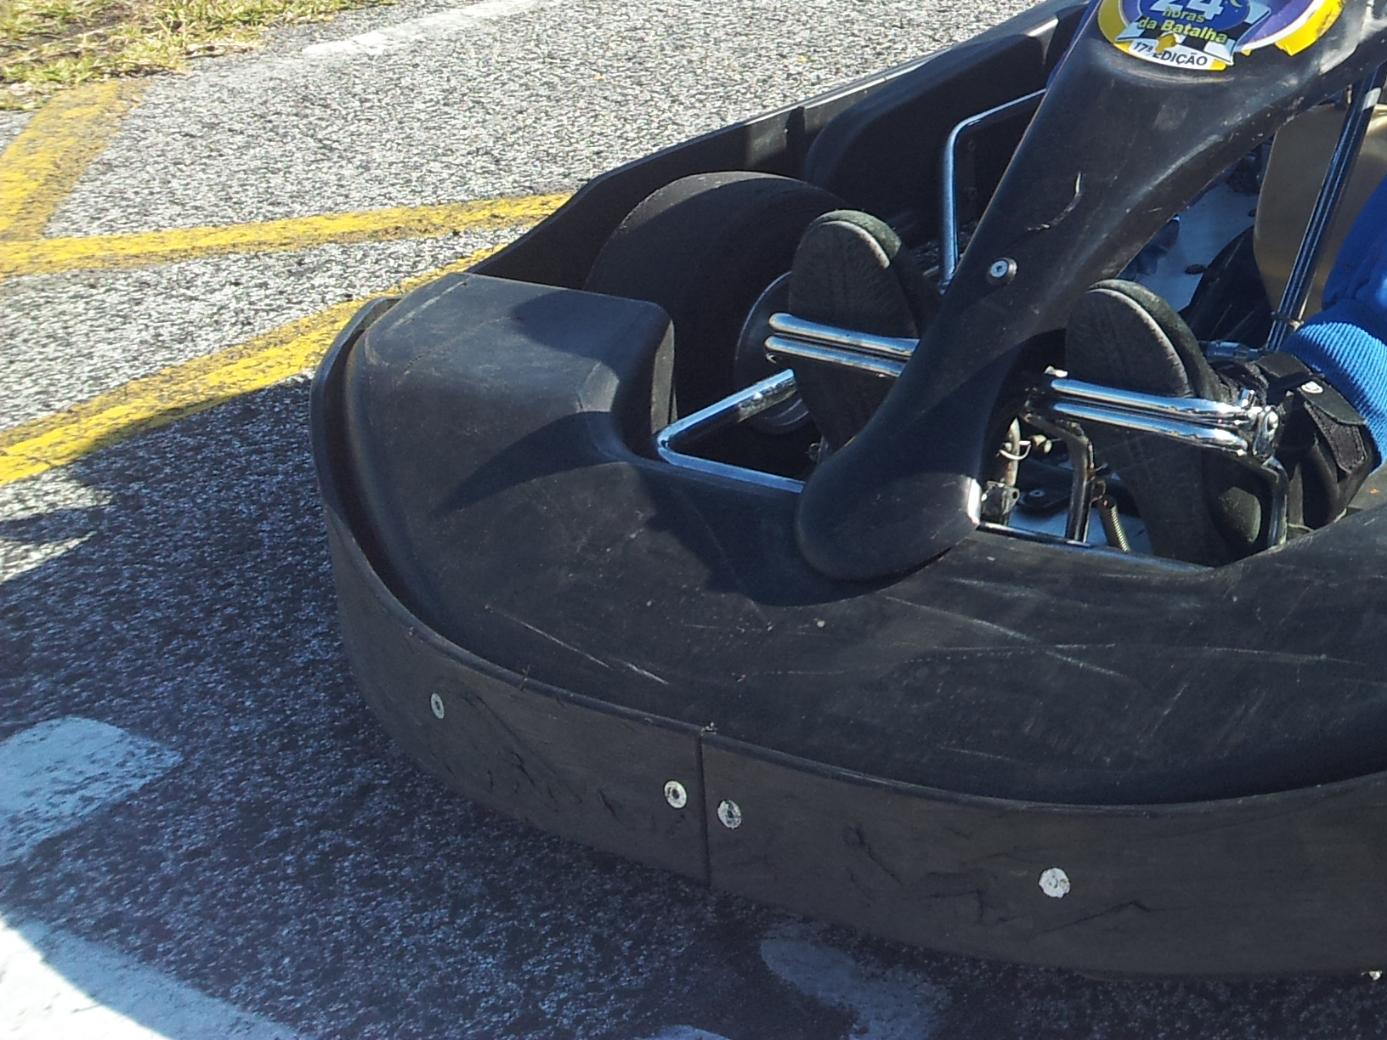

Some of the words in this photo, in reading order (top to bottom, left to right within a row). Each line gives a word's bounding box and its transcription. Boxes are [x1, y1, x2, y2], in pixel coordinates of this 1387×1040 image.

[1162, 5, 1205, 24] horas
[1138, 15, 1157, 30] da
[1160, 18, 1228, 44] Batalha
